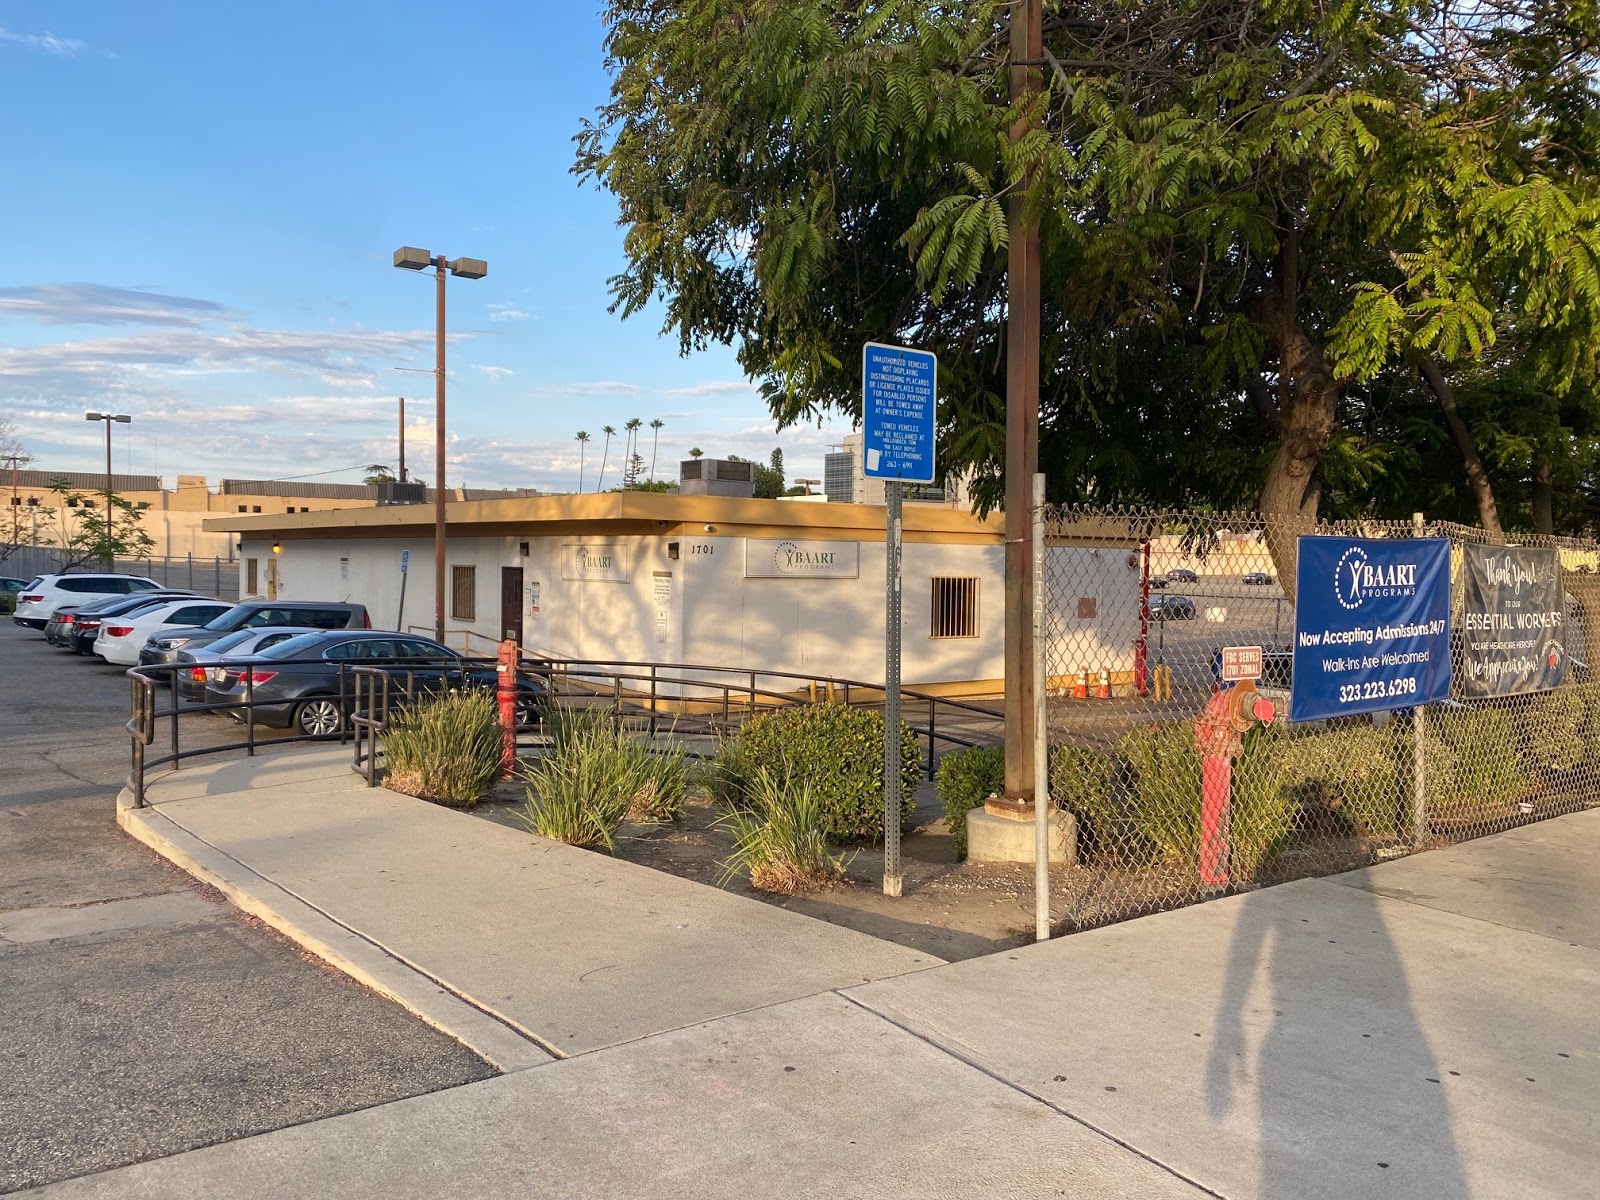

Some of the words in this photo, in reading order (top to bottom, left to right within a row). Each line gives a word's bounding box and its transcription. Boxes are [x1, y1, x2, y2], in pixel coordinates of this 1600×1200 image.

[872, 355, 907, 366] UNAUTHORIZED
[908, 360, 929, 370] VEHICLES
[893, 366, 919, 376] DISPLAYING
[870, 372, 905, 383] DISTINGUISHING
[906, 377, 930, 386] PLACARDS
[869, 380, 876, 388] OR
[877, 382, 896, 390] LICENSE
[896, 384, 914, 393] PLATES
[915, 386, 931, 396] ISSUED
[884, 391, 906, 400] DISABLED
[906, 394, 926, 403] PERSONS
[896, 400, 911, 409] TOWED
[882, 408, 902, 416] OWNER'S
[881, 422, 896, 430] TOWED
[898, 424, 919, 432] VEHICLES
[893, 432, 918, 440] RECLAIMED
[893, 451, 922, 460] TELEPHONING
[692, 545, 714, 554] 1701
[587, 556, 612, 568] BAART
[795, 552, 836, 564] BAART
[1362, 564, 1416, 587] BAART
[1485, 556, 1512, 587] Thank
[1513, 562, 1537, 595] You!
[1362, 587, 1416, 597] PROGRAMS
[1512, 600, 1521, 608] OUR
[1466, 613, 1514, 629] ESSENTIAL
[1517, 612, 1561, 629] WORKERS
[1299, 632, 1321, 647] Now
[1322, 627, 1373, 645] Accepting
[1375, 623, 1429, 640] Admissions
[1430, 620, 1445, 634] 24/7
[1471, 642, 1479, 650] YO
[1226, 652, 1237, 663] FDC
[1239, 652, 1259, 662] SERVES
[1322, 658, 1360, 672] Walk-Ins
[1362, 656, 1379, 668] Are
[1381, 649, 1429, 666] Welcomed
[1226, 665, 1239, 675] 1701
[1240, 664, 1259, 675] ZONAL
[1468, 656, 1482, 681] We
[1522, 654, 1538, 681] You!
[1340, 677, 1416, 703] 323.223.6298
